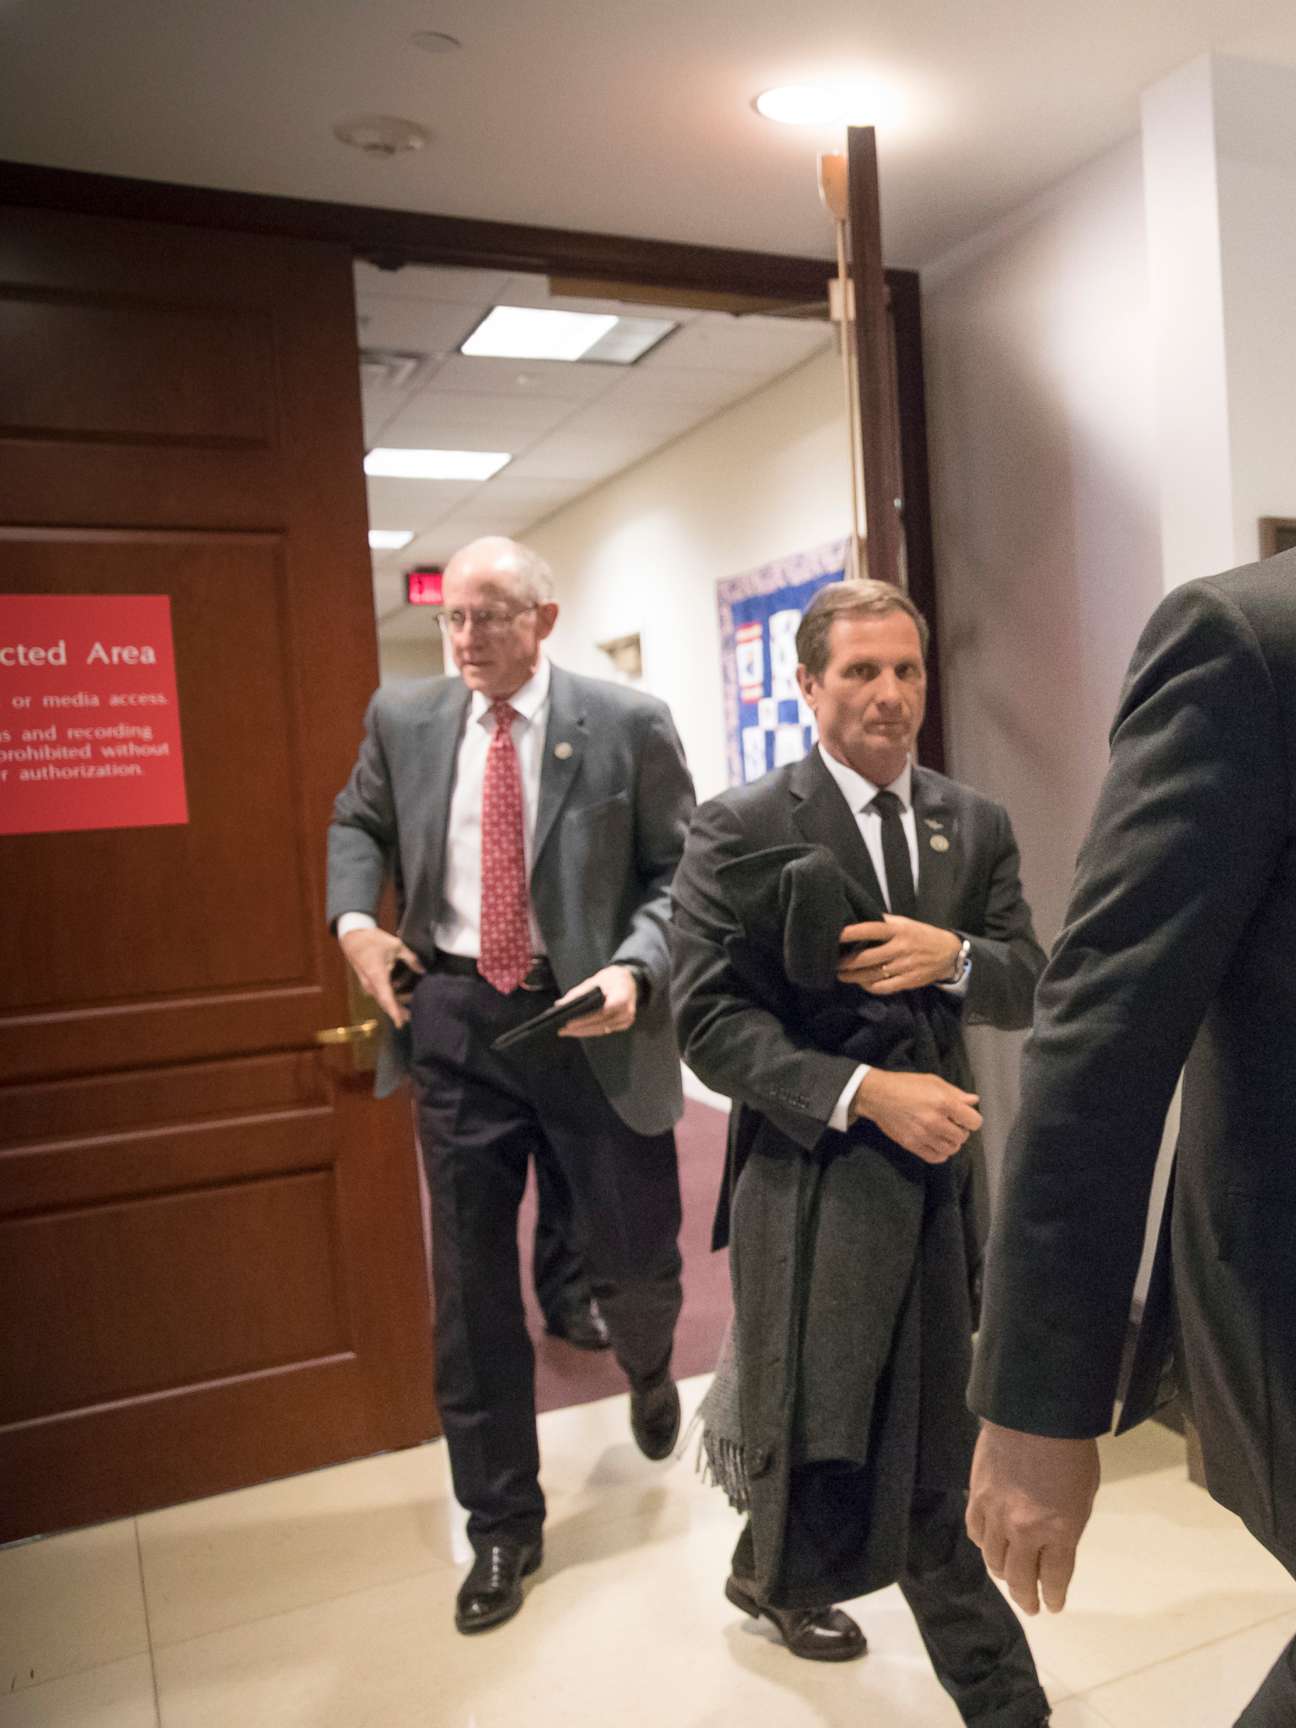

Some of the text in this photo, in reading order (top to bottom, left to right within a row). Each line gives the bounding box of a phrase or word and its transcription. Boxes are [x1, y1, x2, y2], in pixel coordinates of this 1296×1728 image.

[0, 640, 156, 666] cted Area
[12, 695, 31, 708] or
[42, 692, 100, 708] media
[22, 724, 57, 741] and
[67, 723, 153, 741] recording
[101, 742, 169, 758] without
